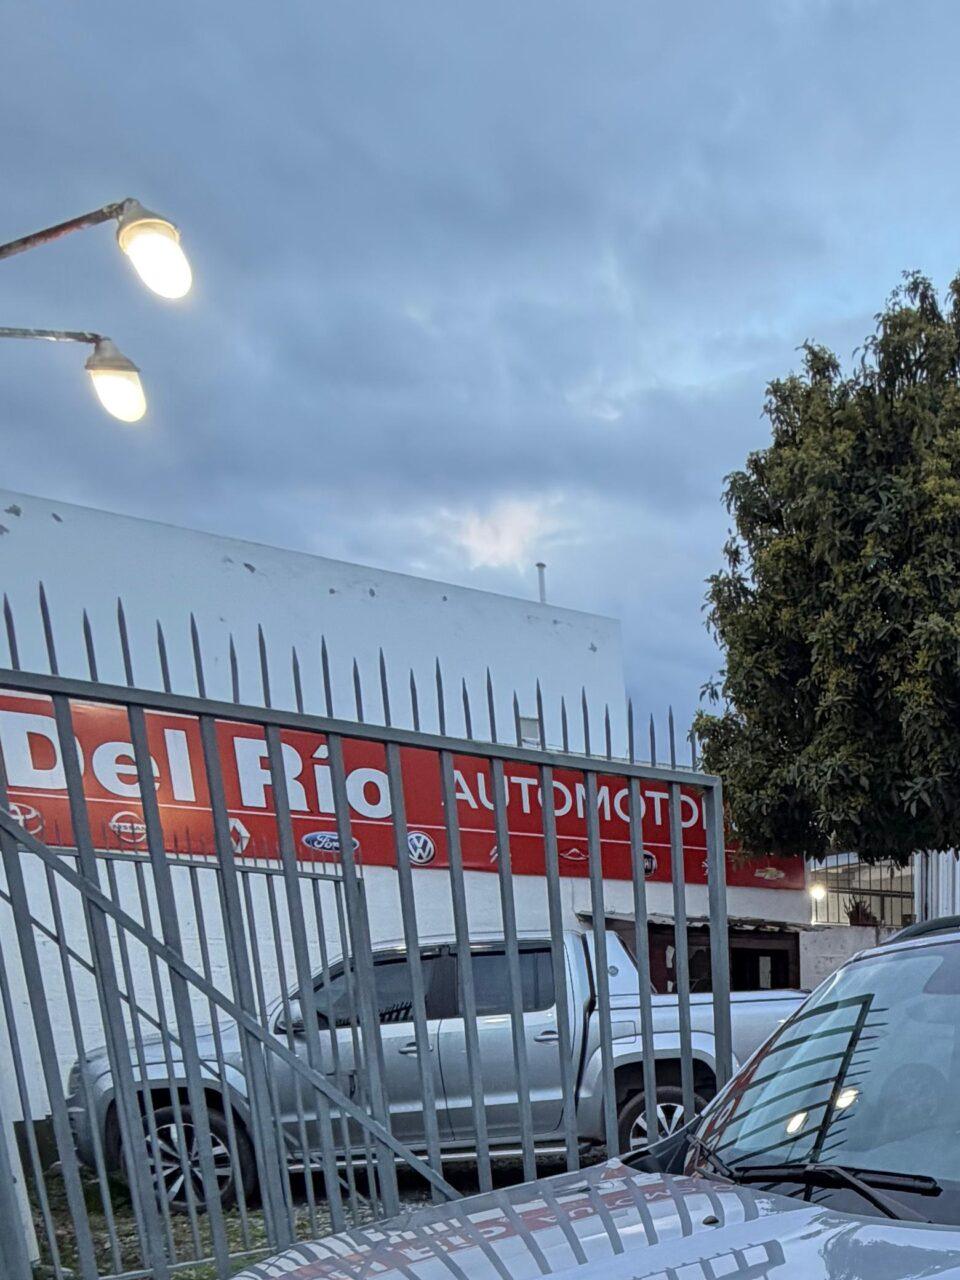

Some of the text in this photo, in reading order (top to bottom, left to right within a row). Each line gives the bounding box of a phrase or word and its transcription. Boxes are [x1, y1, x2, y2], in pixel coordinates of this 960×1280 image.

[0, 709, 707, 830] Del Río AUTOMOTO
